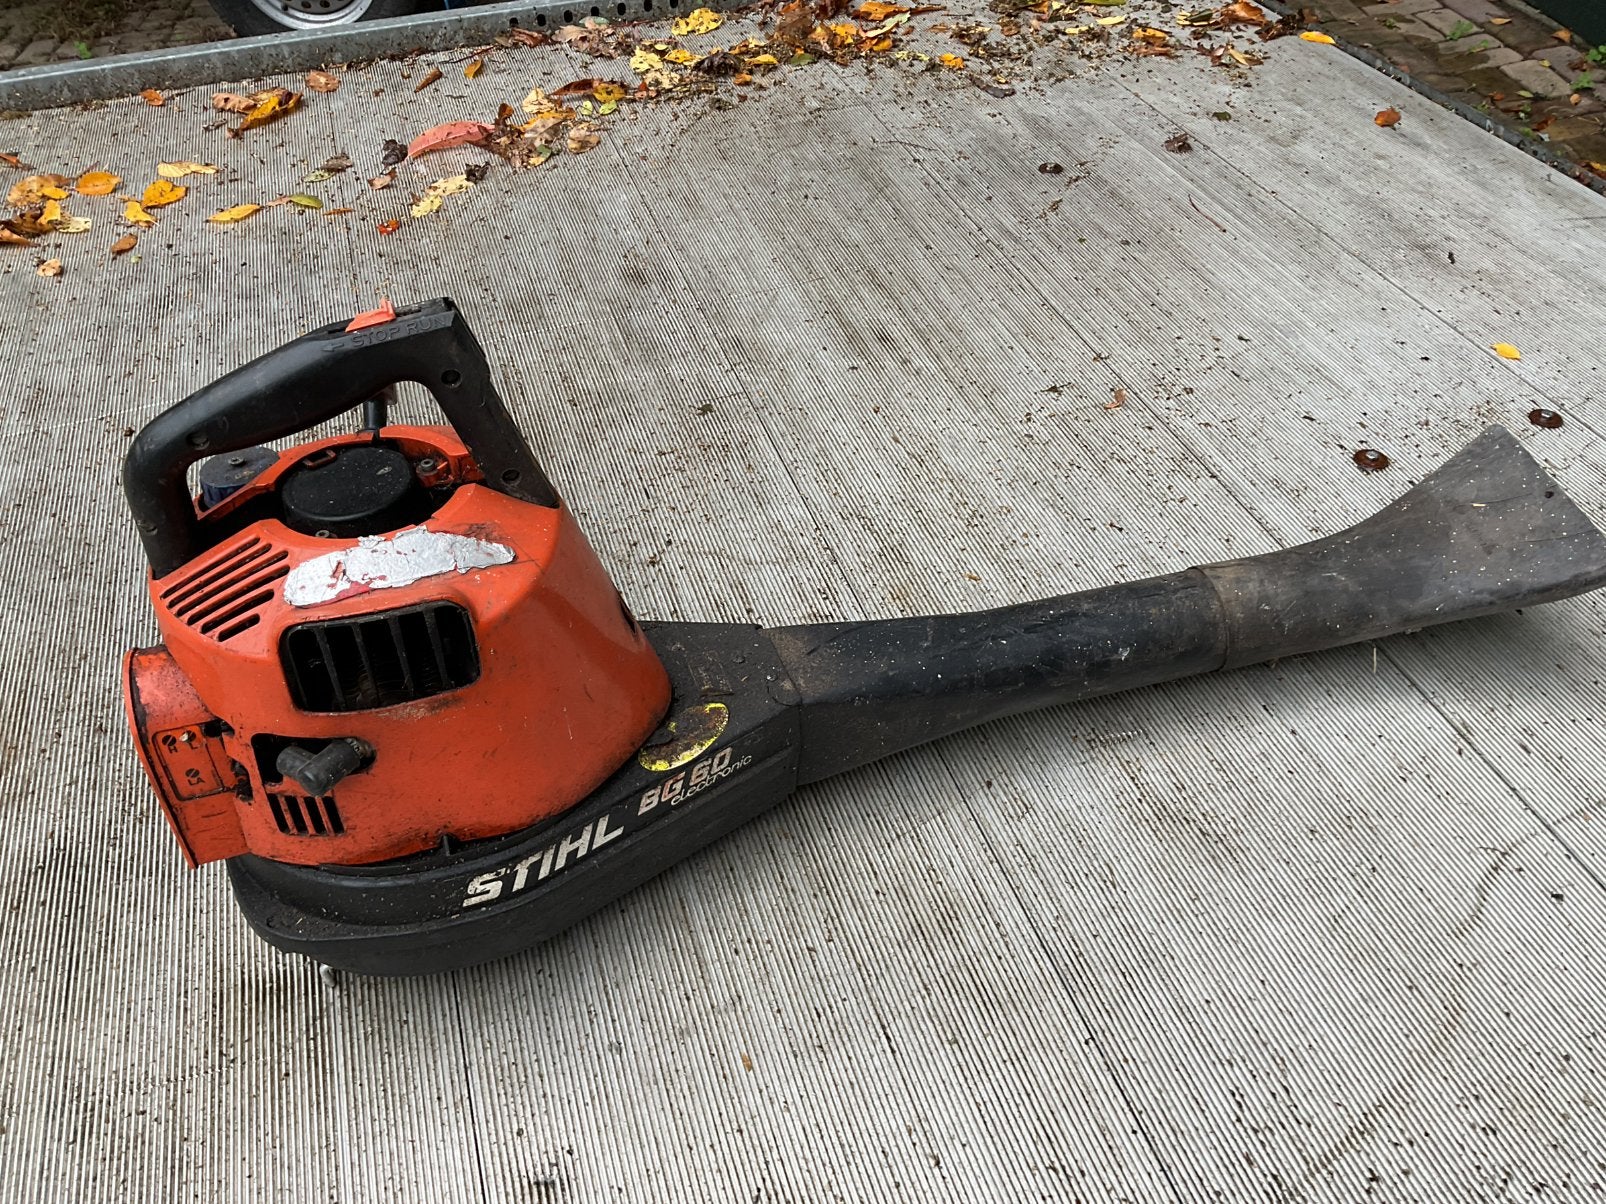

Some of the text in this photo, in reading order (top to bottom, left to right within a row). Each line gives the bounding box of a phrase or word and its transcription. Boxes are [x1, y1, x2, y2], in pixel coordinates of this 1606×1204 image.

[351, 316, 448, 347] STOP RUN
[189, 742, 198, 750] L
[638, 747, 733, 816] BG 60
[671, 755, 752, 806] electronic
[462, 814, 624, 907] STIHL
